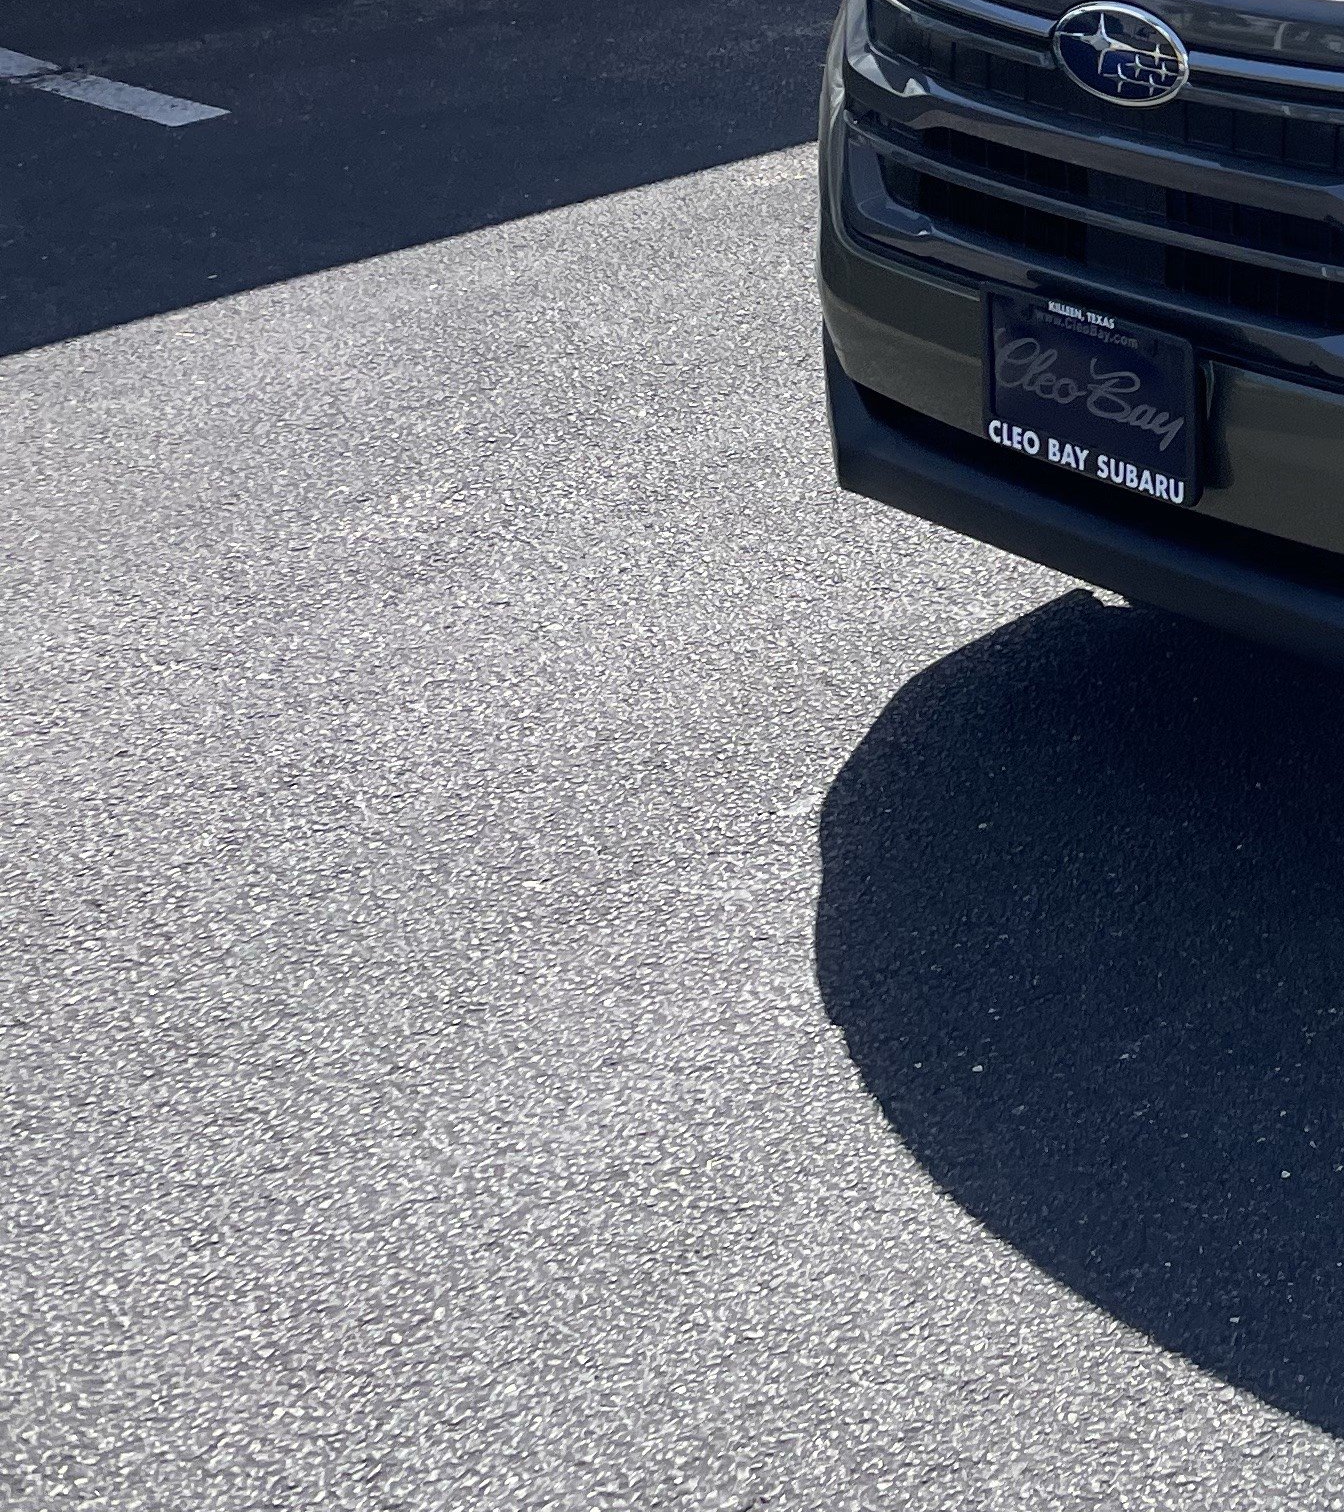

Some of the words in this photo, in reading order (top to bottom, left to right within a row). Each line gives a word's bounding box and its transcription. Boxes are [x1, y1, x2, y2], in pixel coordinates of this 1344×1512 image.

[1048, 300, 1085, 321] KILLEEN,
[1086, 311, 1115, 330] TEXAS
[993, 326, 1085, 405] Cleo
[1086, 356, 1185, 451] Bay
[988, 419, 1040, 456] CLEO
[1047, 438, 1090, 472] BAY
[1096, 454, 1185, 504] SUBARU
